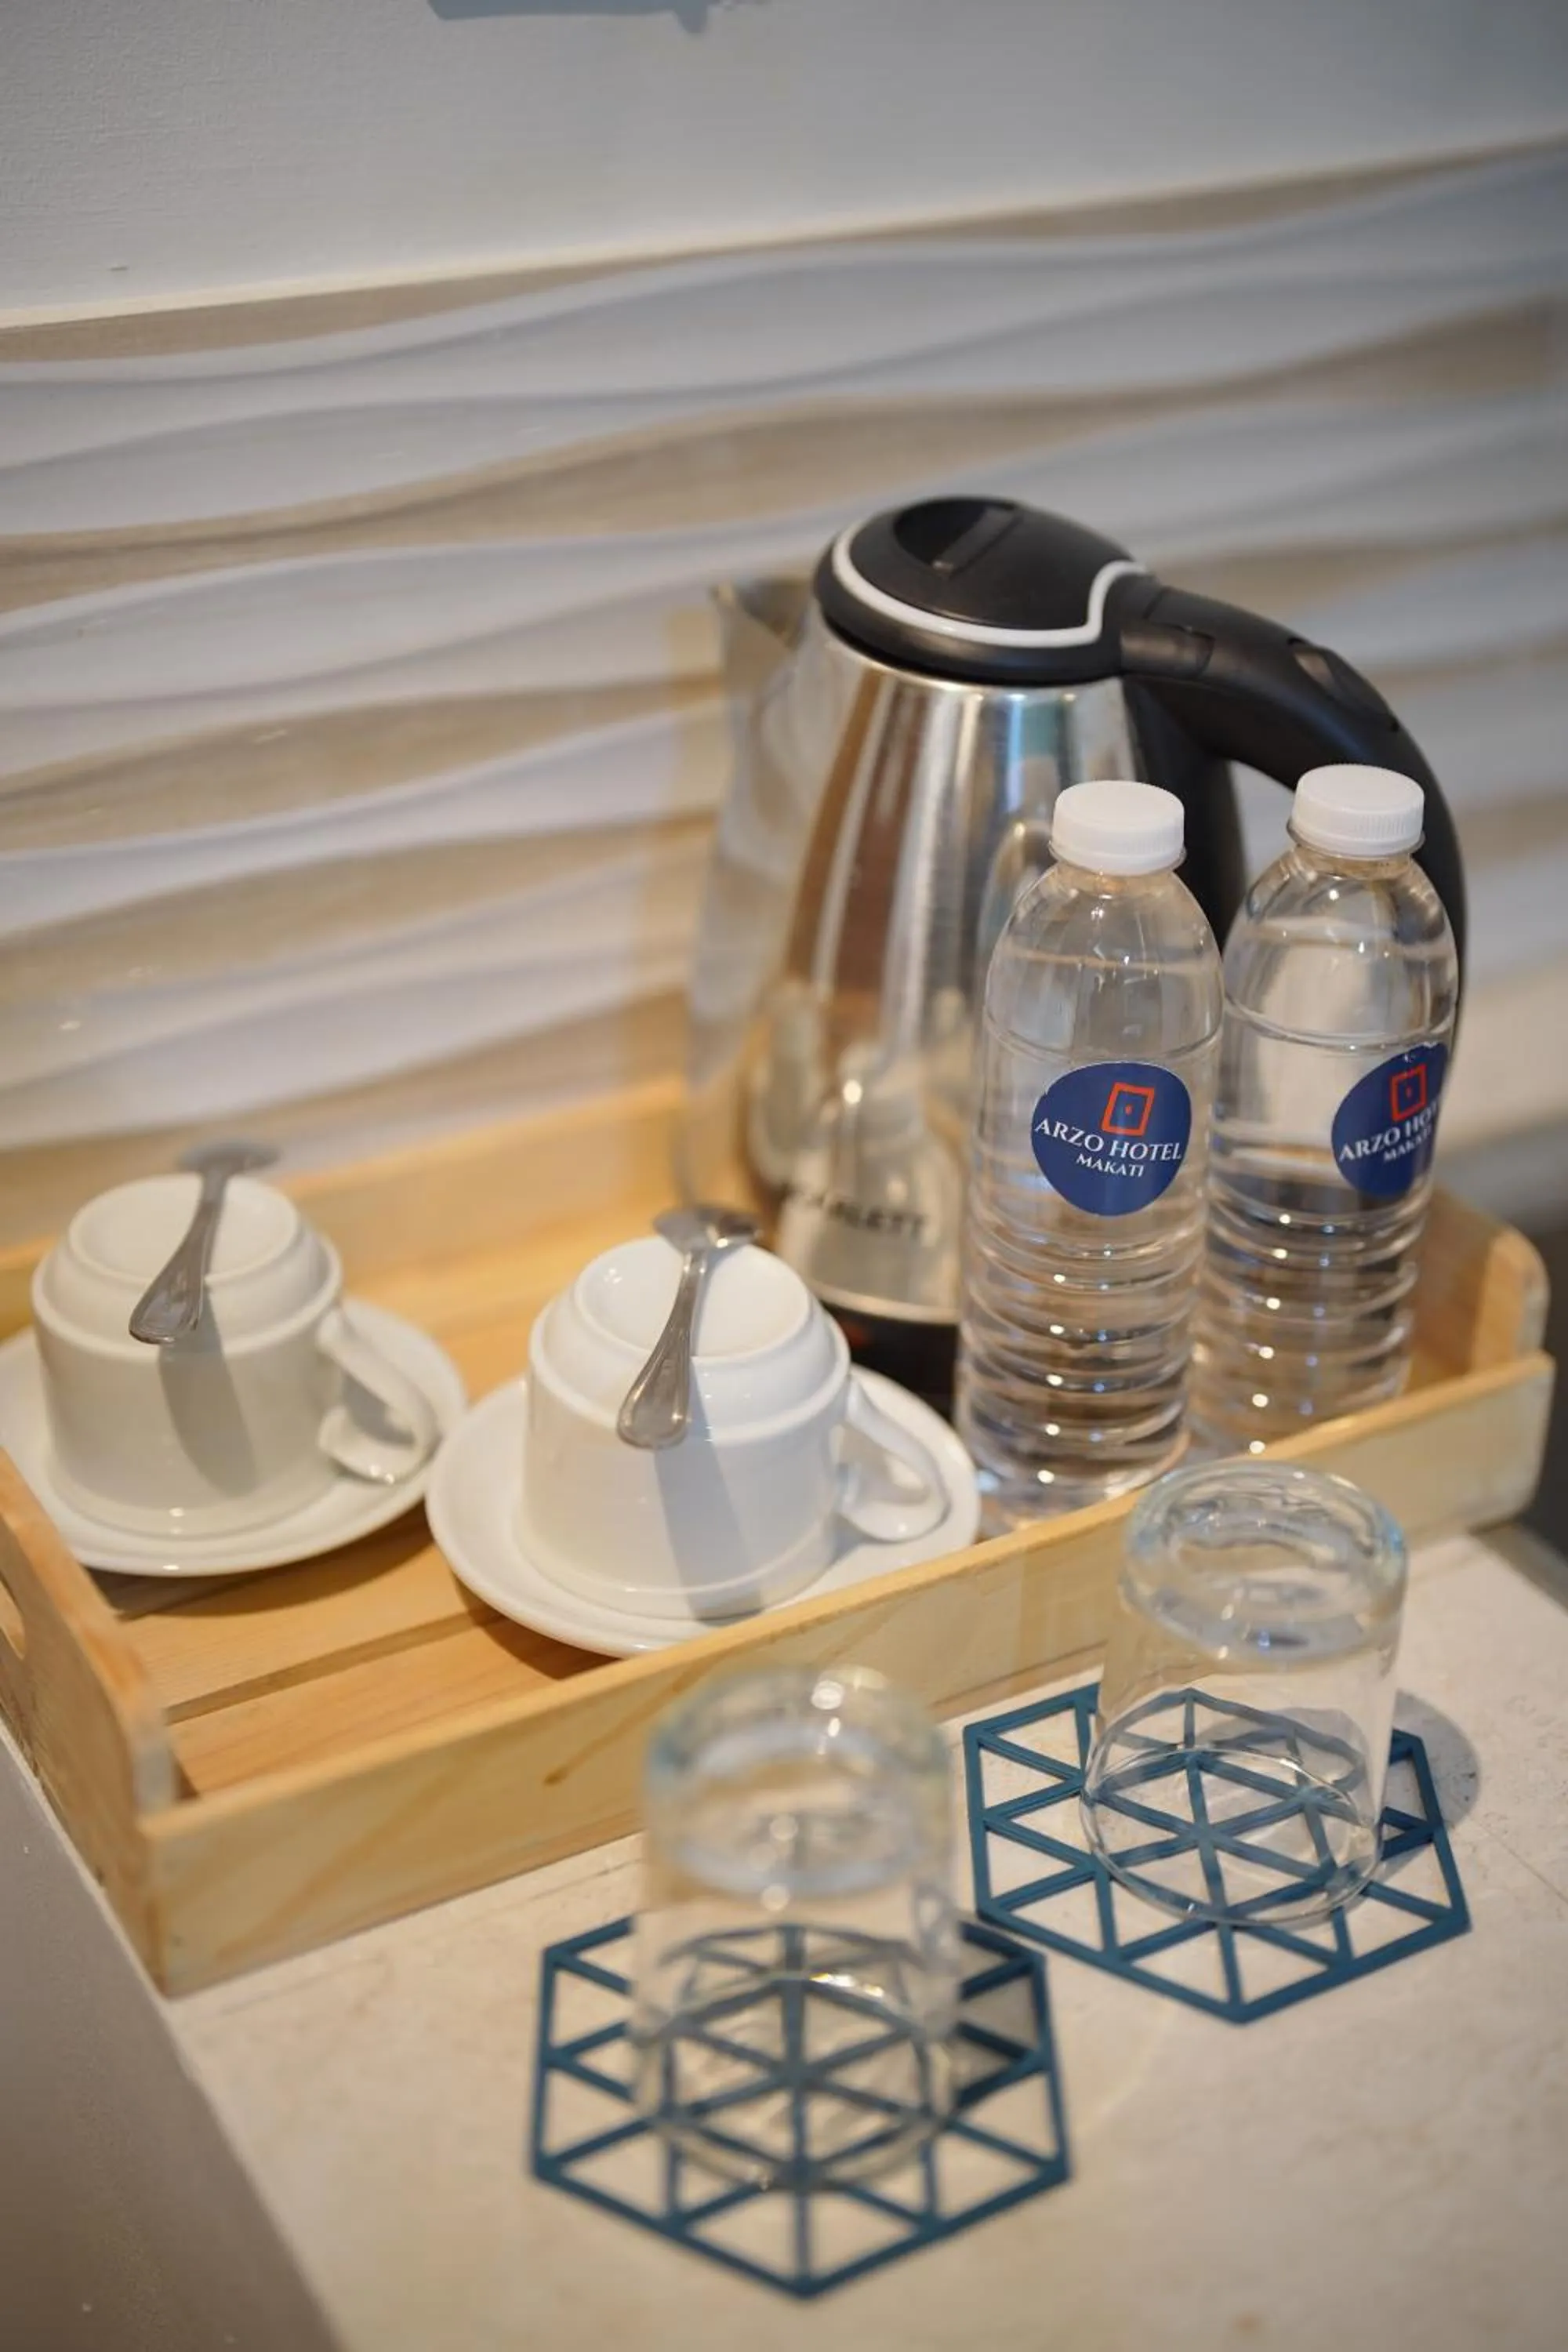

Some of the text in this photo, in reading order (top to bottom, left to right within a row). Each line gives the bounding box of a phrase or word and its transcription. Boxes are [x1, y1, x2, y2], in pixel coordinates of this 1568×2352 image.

[1034, 1118, 1181, 1161] ARZO HOTEL
[1338, 1127, 1400, 1162] ARZO
[1076, 1153, 1145, 1177] MAKATI
